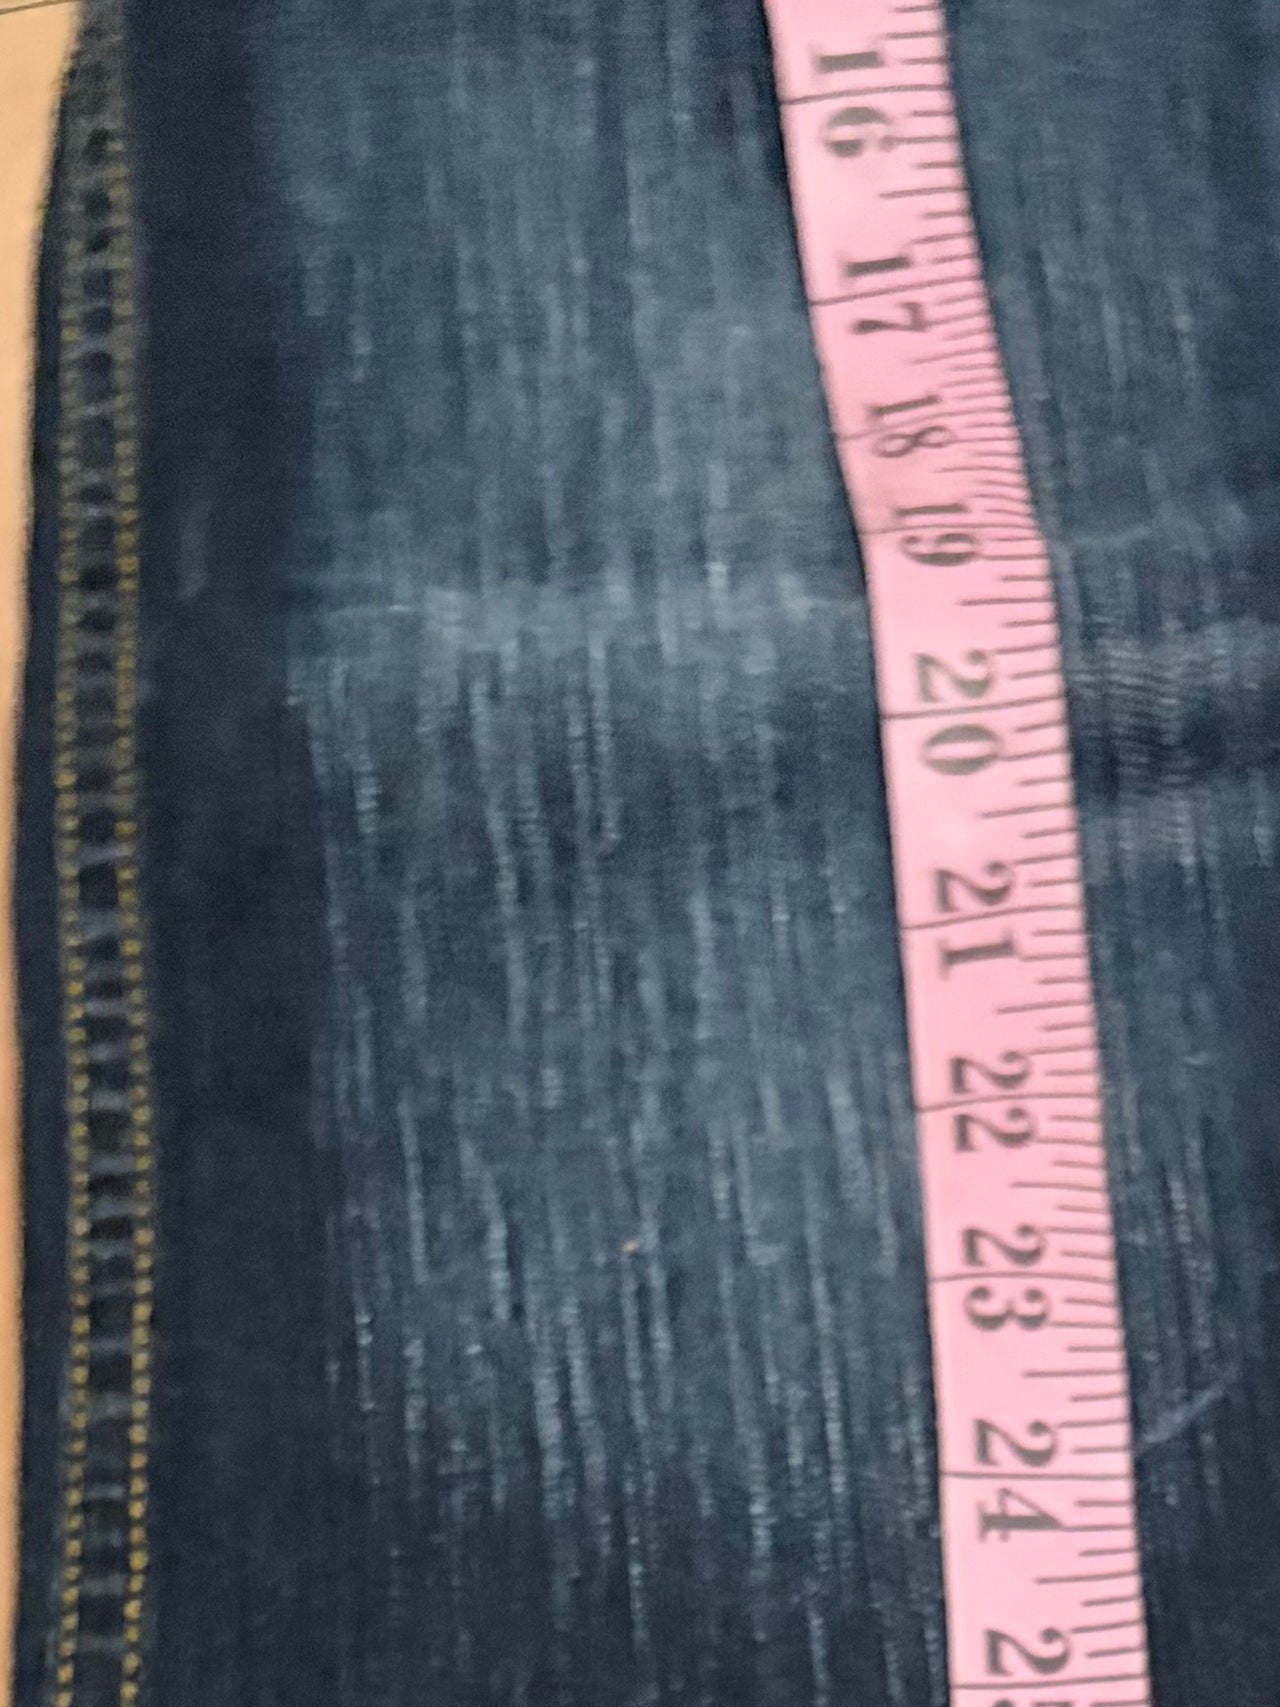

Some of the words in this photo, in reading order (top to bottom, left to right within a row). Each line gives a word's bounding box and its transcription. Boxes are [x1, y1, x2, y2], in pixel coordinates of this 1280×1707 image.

[814, 51, 892, 158] 16
[842, 251, 925, 336] 17
[866, 395, 951, 458] 18
[894, 502, 978, 567] 19
[915, 650, 1002, 776] 20
[934, 860, 1020, 979] 21
[950, 1050, 1039, 1153] 22
[962, 1225, 1050, 1331] 23
[972, 1418, 1063, 1541] 24
